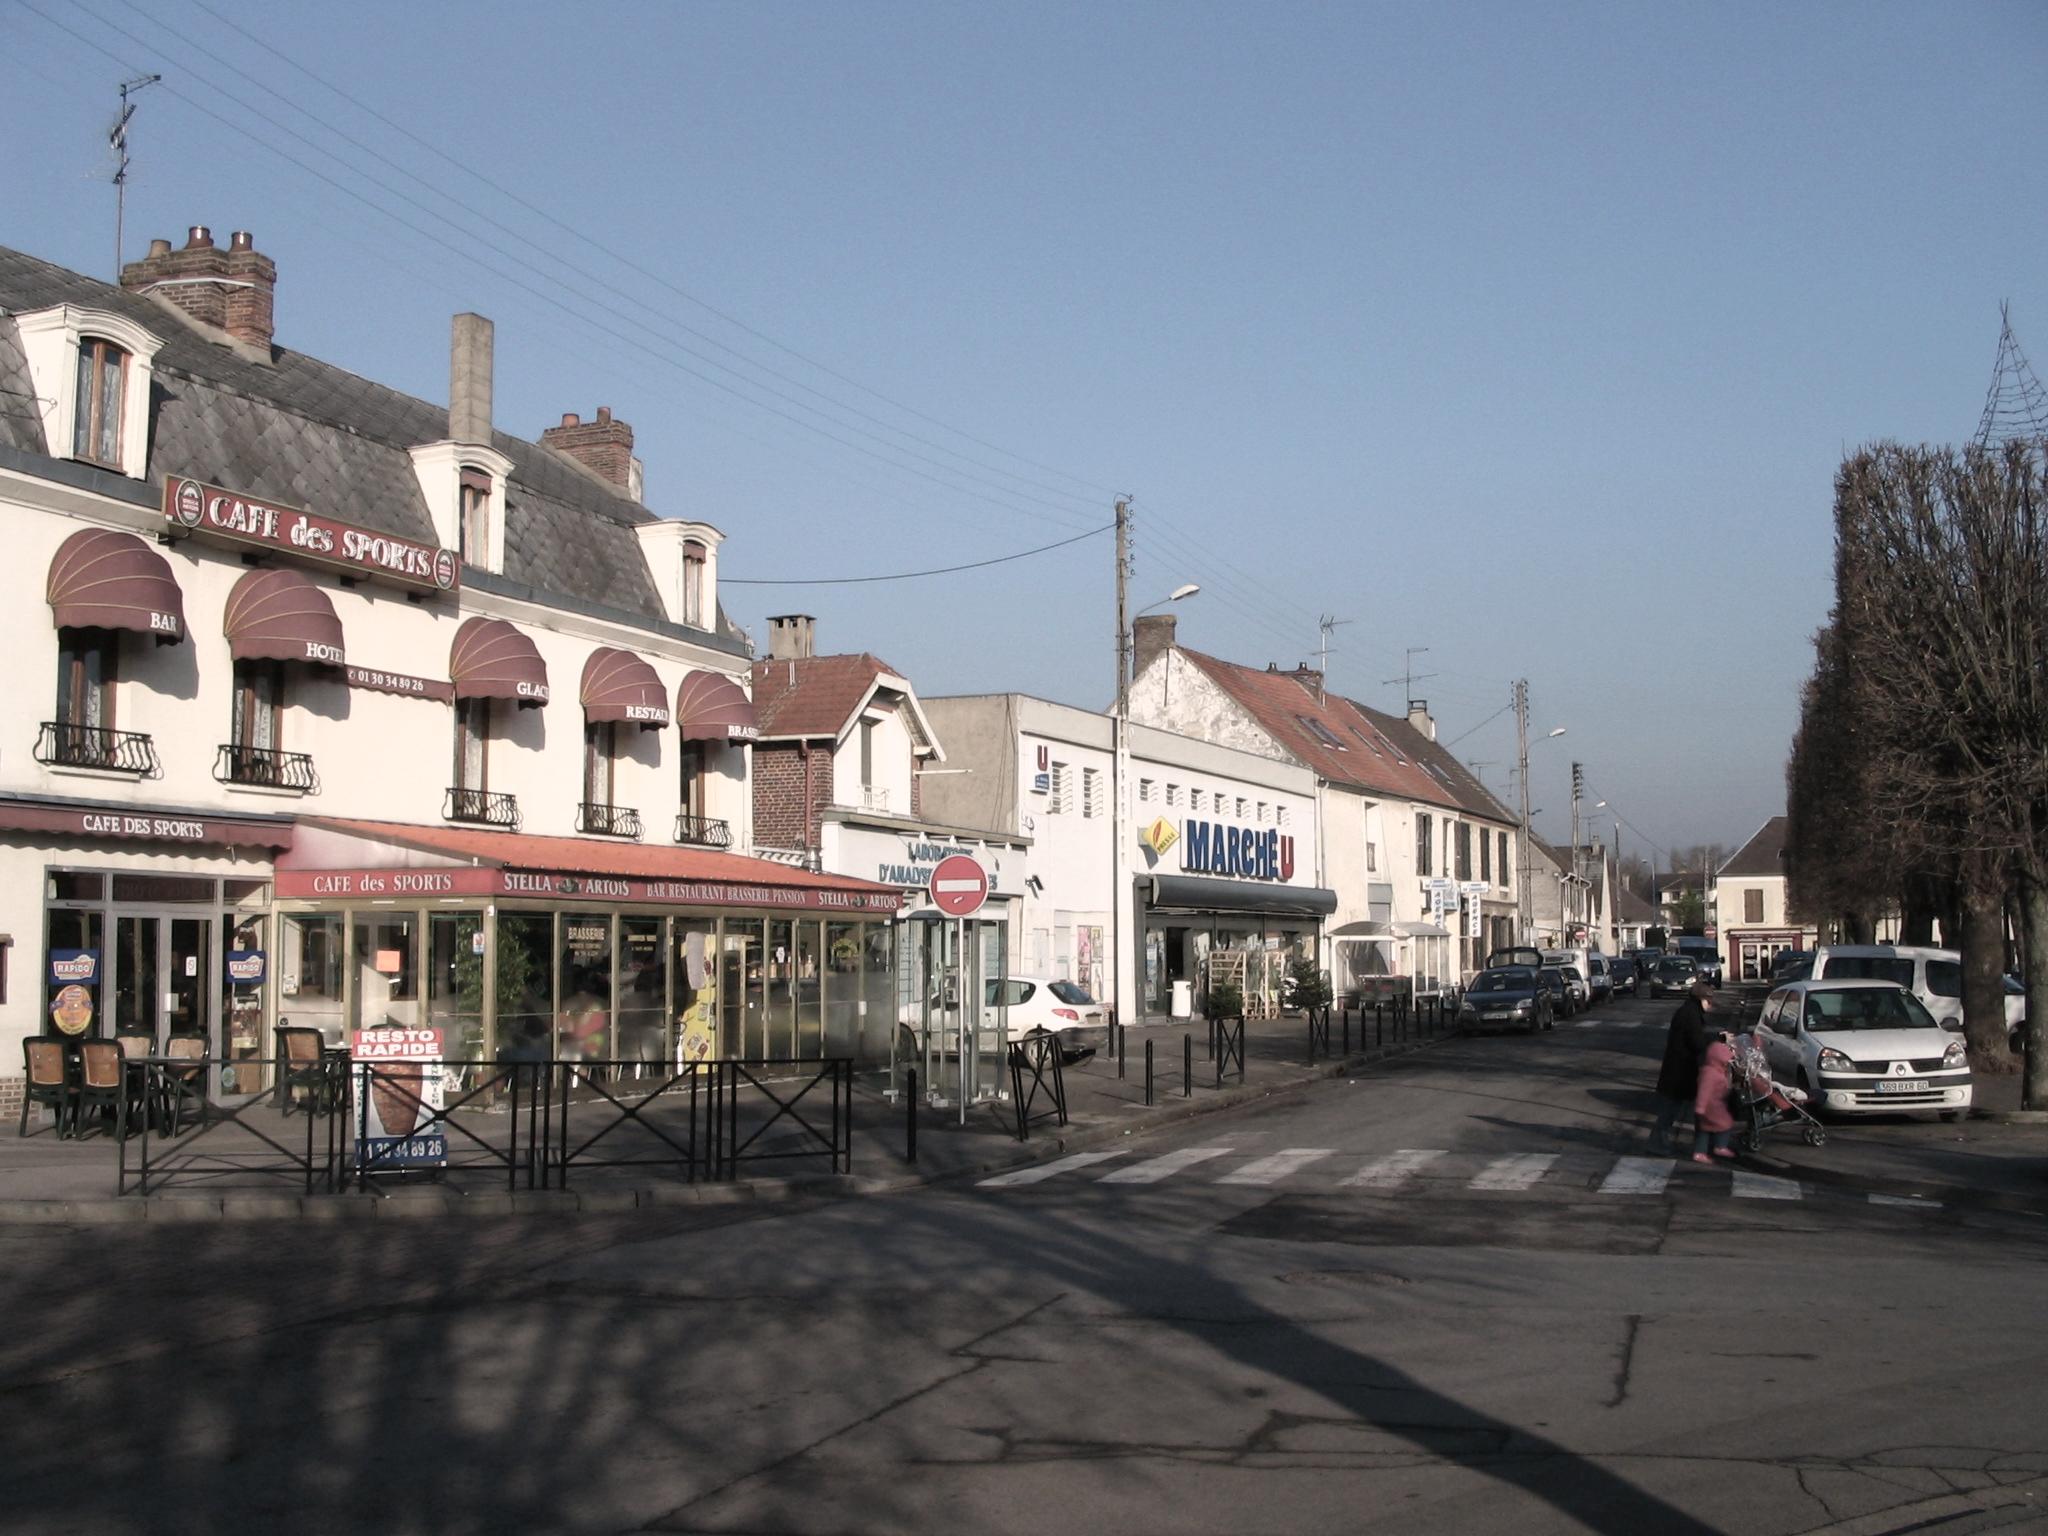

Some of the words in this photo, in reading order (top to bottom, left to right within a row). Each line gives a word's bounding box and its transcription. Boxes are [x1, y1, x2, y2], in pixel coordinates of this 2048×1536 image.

[209, 497, 280, 538] CAFE
[290, 516, 334, 552] des
[342, 530, 431, 576] SPORTS
[150, 612, 177, 632] BAR
[358, 670, 369, 682] 01
[372, 673, 384, 685] 30
[386, 675, 397, 688] 34
[1037, 744, 1048, 772] U
[83, 815, 120, 832] CAFE
[124, 817, 151, 834] DES
[154, 820, 203, 838] SPORTS
[1280, 835, 1295, 880] U
[313, 876, 350, 892] CAFE
[360, 874, 385, 891] des
[393, 874, 451, 891] SPORTS
[504, 873, 552, 891] STELLA
[647, 883, 665, 897] BAR
[818, 892, 849, 906] STELLA
[1433, 891, 1442, 927] AGENC
[57, 963, 91, 973] RAPIDO
[361, 1030, 435, 1043] RESTO
[357, 1042, 439, 1056] RAPIDE
[411, 1141, 425, 1156] 89
[428, 1140, 442, 1155] 26
